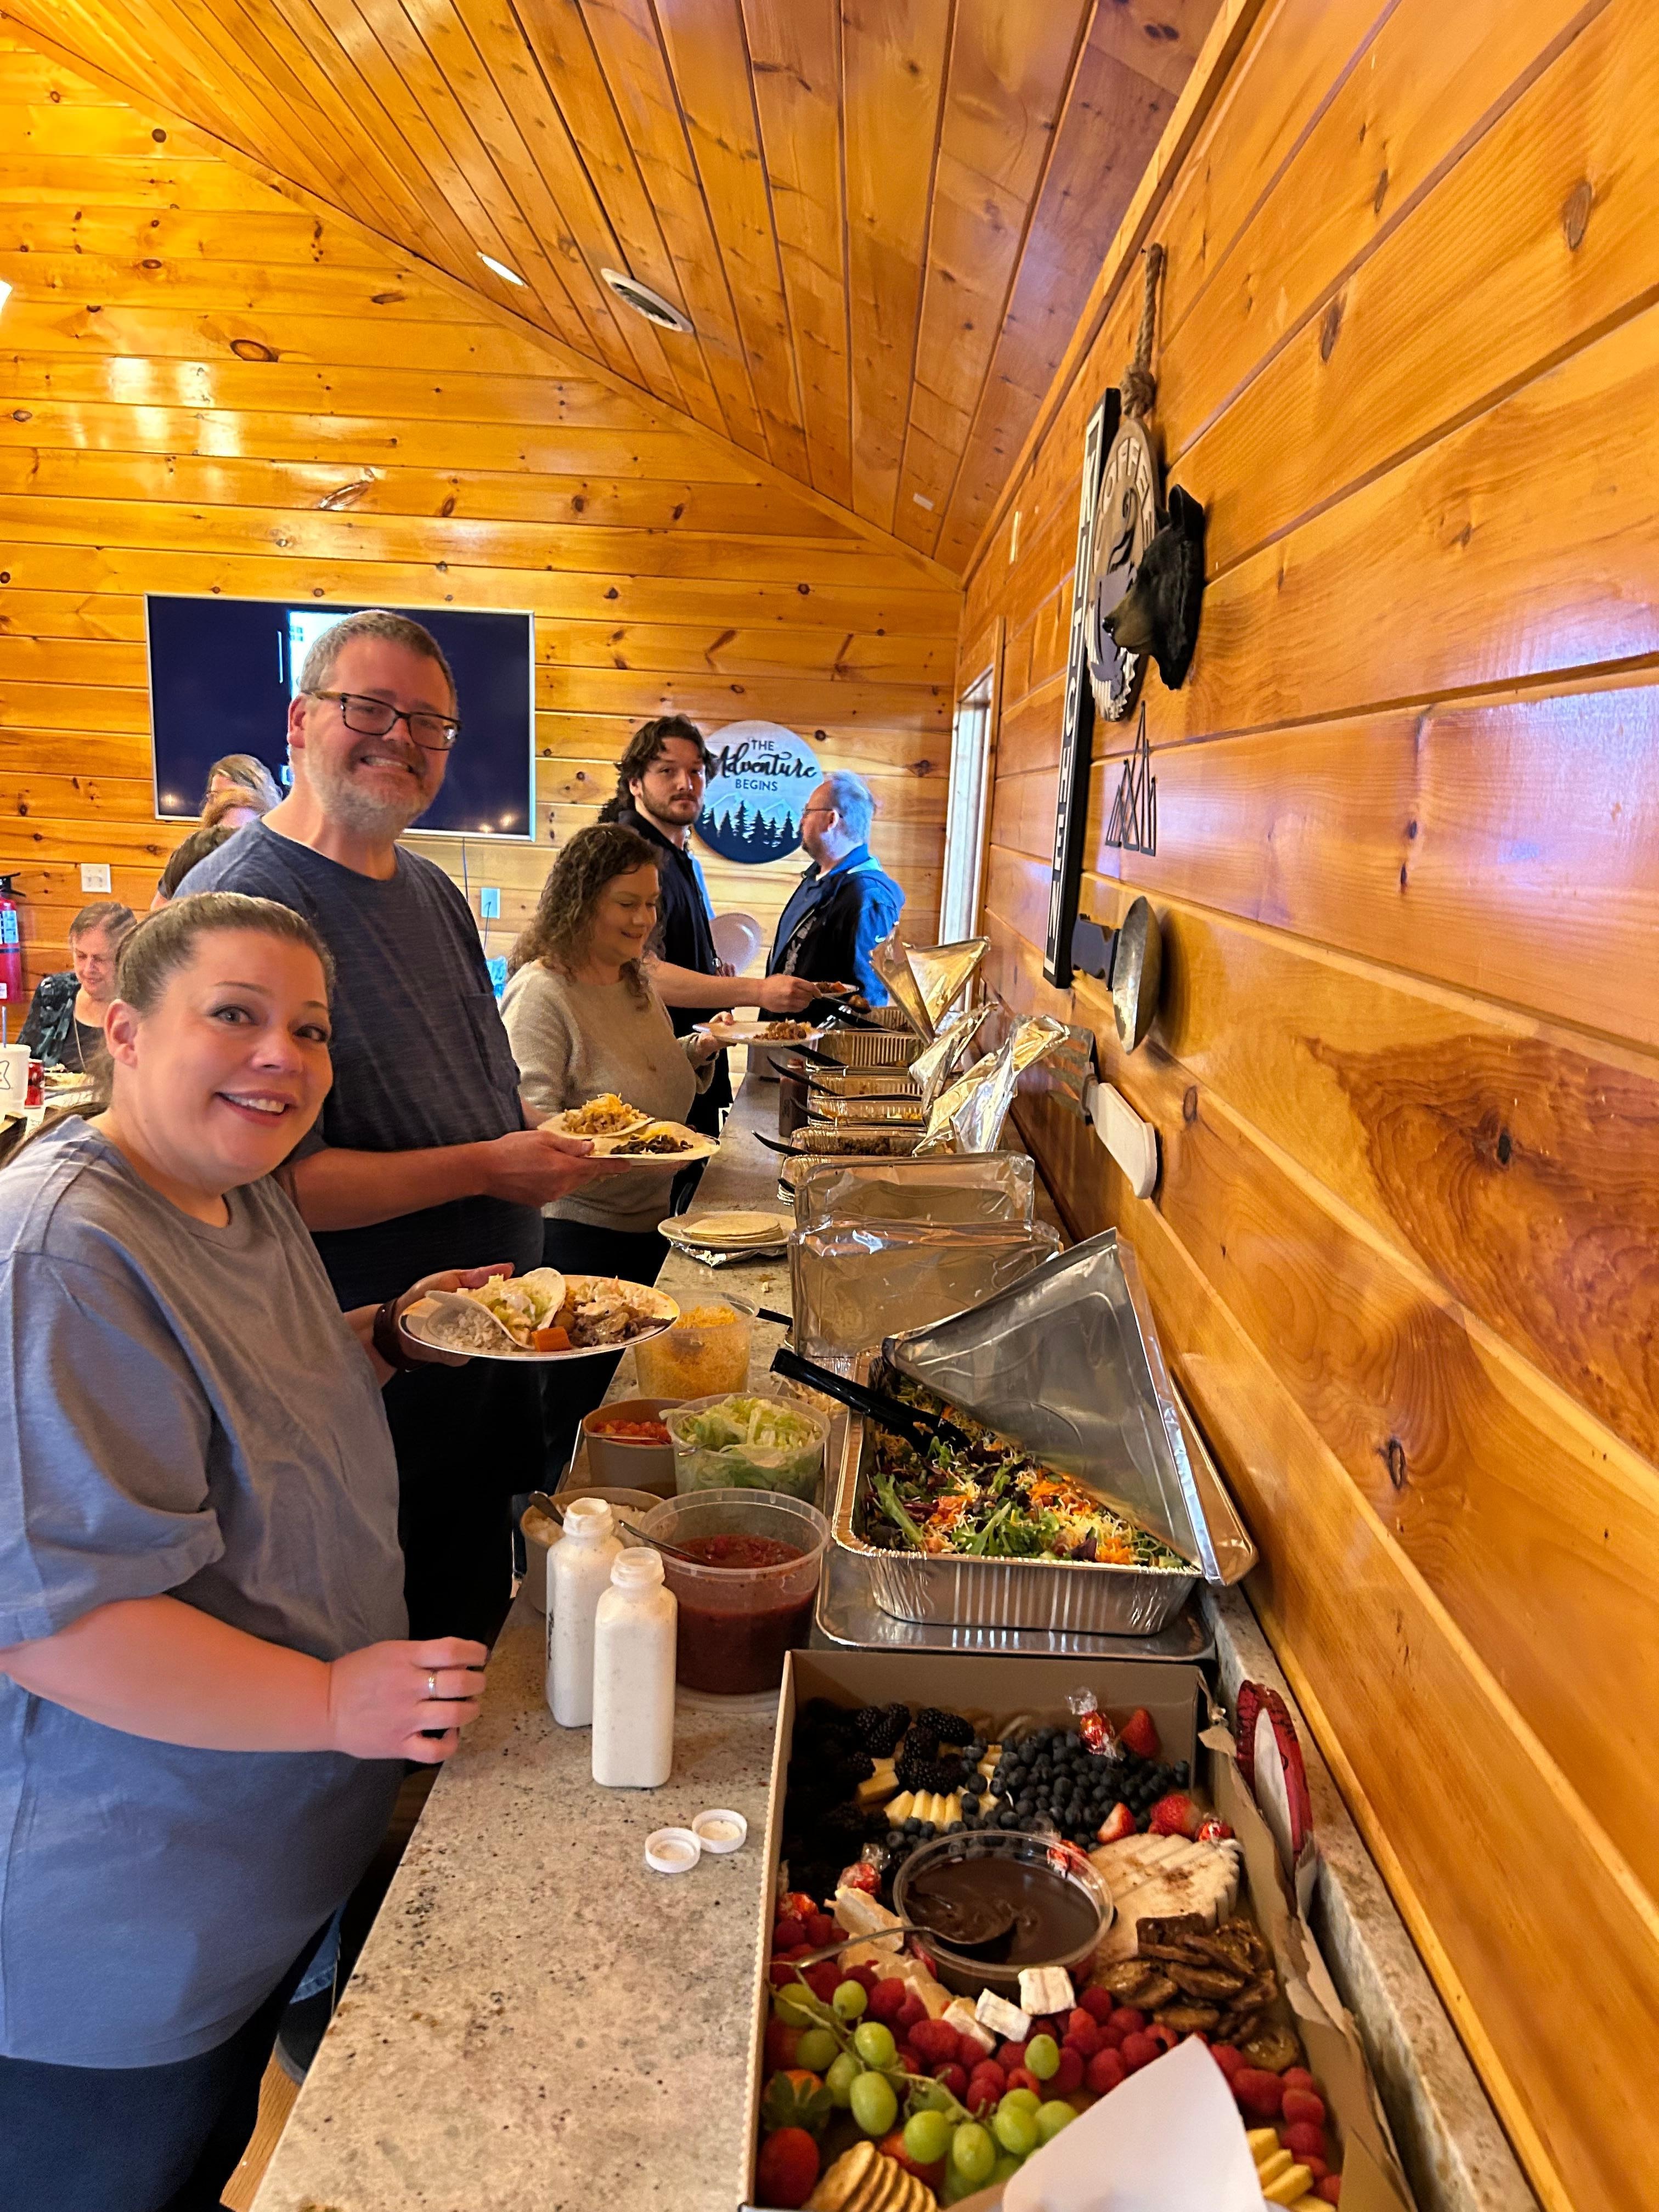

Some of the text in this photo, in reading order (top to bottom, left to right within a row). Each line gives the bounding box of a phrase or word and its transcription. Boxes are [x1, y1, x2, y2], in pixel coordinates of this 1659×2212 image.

[1048, 450, 1096, 941] KITCHEN
[751, 739, 775, 751] THE
[719, 742, 817, 778] Adventure
[735, 778, 778, 792] BEGINS
